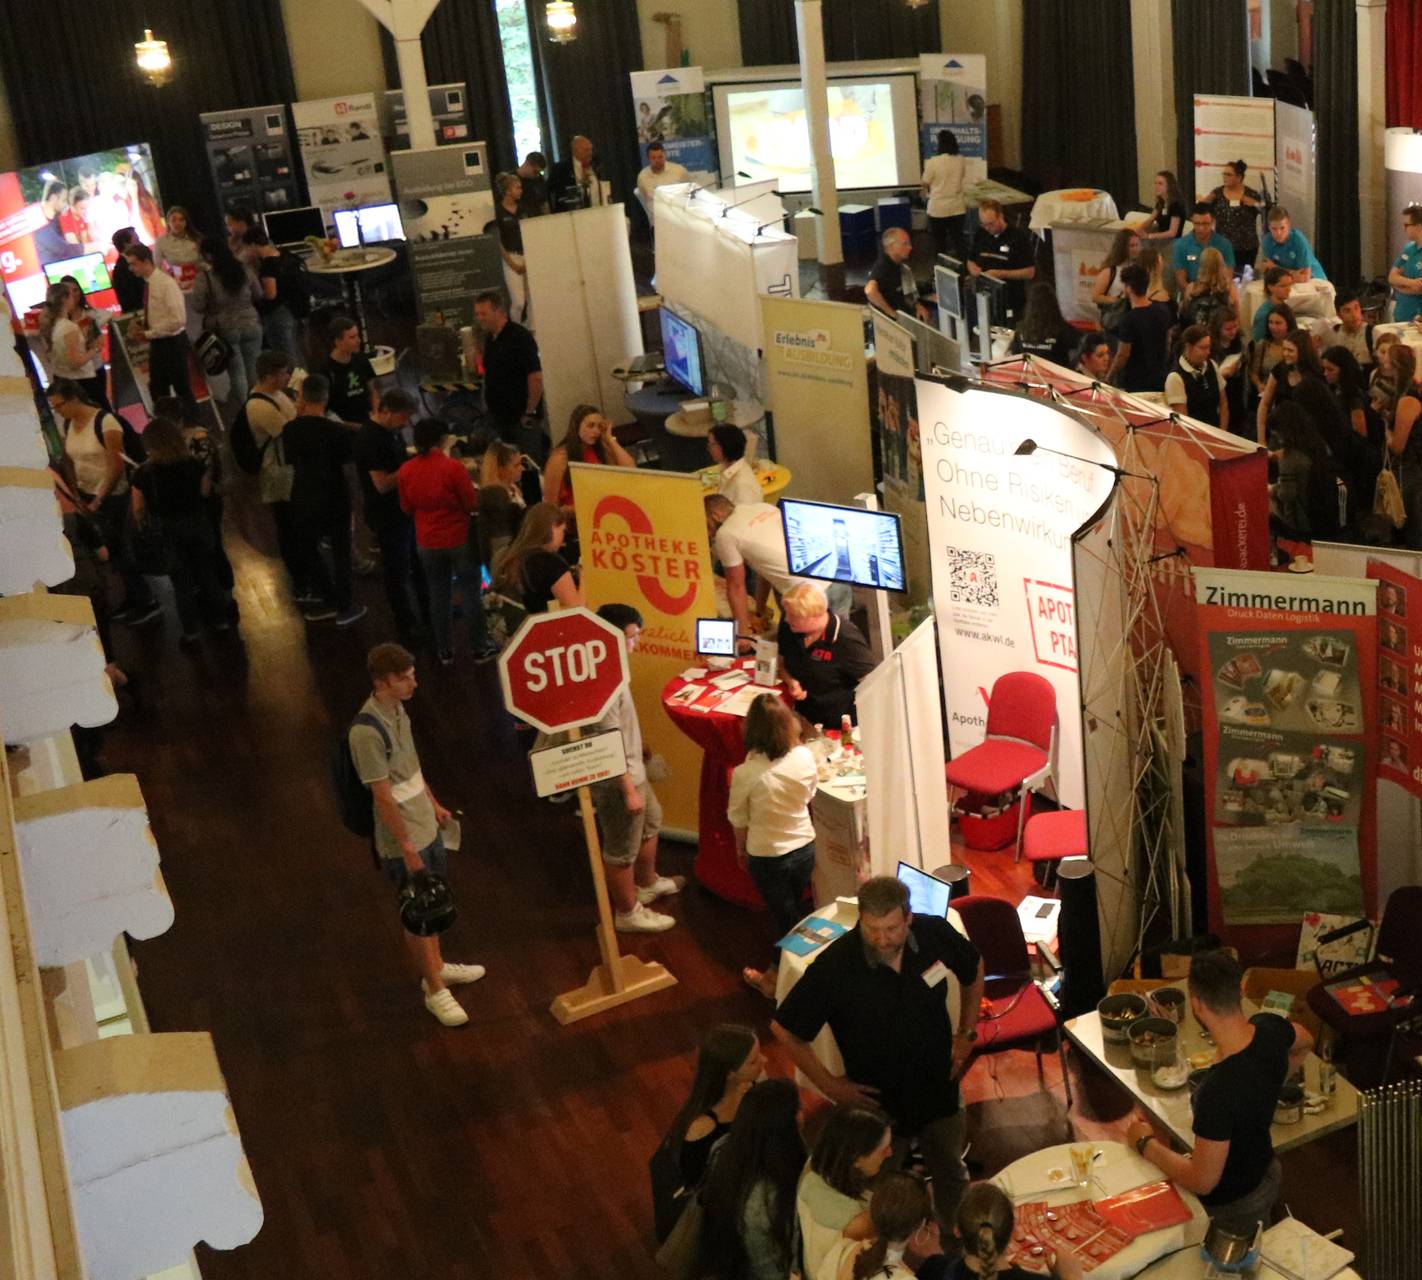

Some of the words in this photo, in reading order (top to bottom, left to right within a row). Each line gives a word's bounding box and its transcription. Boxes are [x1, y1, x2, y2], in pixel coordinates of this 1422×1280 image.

[775, 333, 816, 348] Erlebnis
[936, 458, 999, 491] Ohne
[1008, 471, 1072, 516] Risiken
[591, 531, 699, 556] APOTHEKE
[591, 546, 701, 580] KÖSTER
[1038, 596, 1073, 626] APOT
[1205, 586, 1367, 616] Zimmermann
[1227, 609, 1254, 620] Druck
[1255, 610, 1284, 621] Daten
[1286, 612, 1321, 624] Logistik
[954, 627, 1016, 649] www.akwl.de
[1050, 630, 1077, 660] PTA
[1226, 636, 1288, 646] Zimmermann
[523, 639, 607, 693] STOP
[951, 711, 985, 728] Apoth
[1222, 725, 1284, 742] Zimmermann
